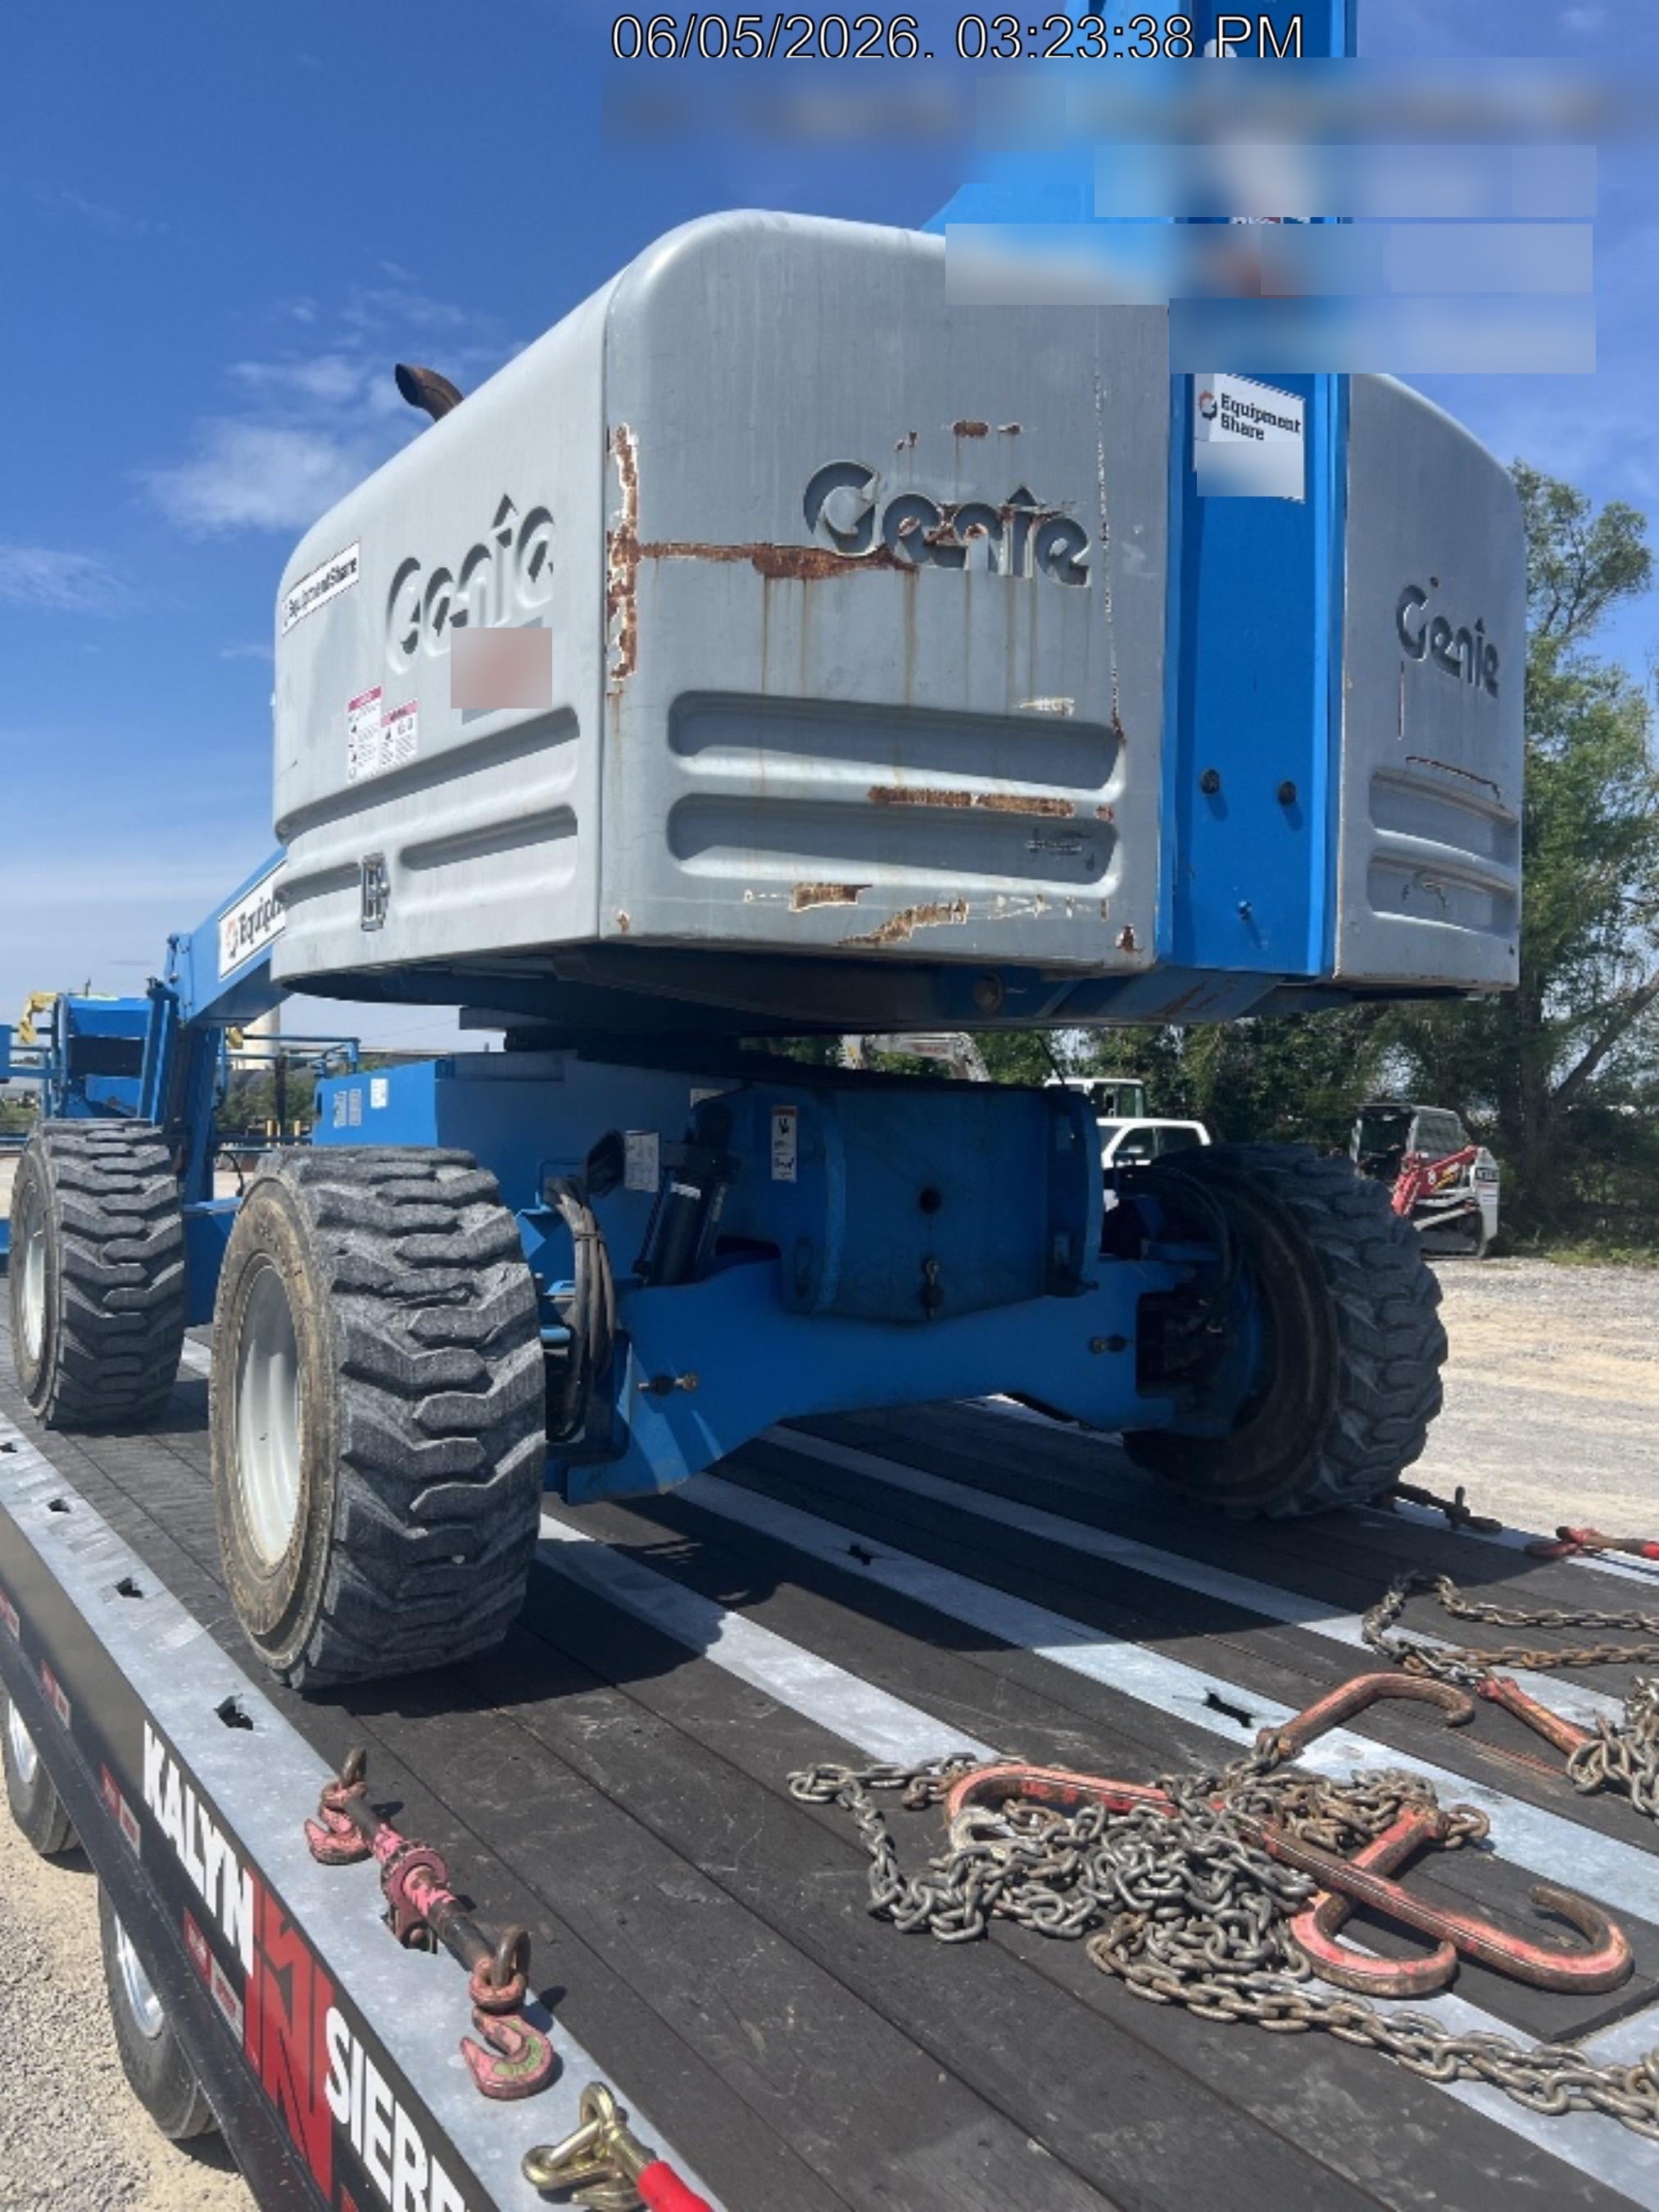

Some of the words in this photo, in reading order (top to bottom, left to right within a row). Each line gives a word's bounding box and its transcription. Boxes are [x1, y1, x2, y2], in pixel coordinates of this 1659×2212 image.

[1221, 392, 1301, 434] Equipment
[1221, 412, 1265, 441] Share
[803, 460, 1091, 587] Genie
[385, 493, 554, 675] Genie
[1396, 584, 1500, 698] Genie
[143, 1720, 253, 1979] KALYN
